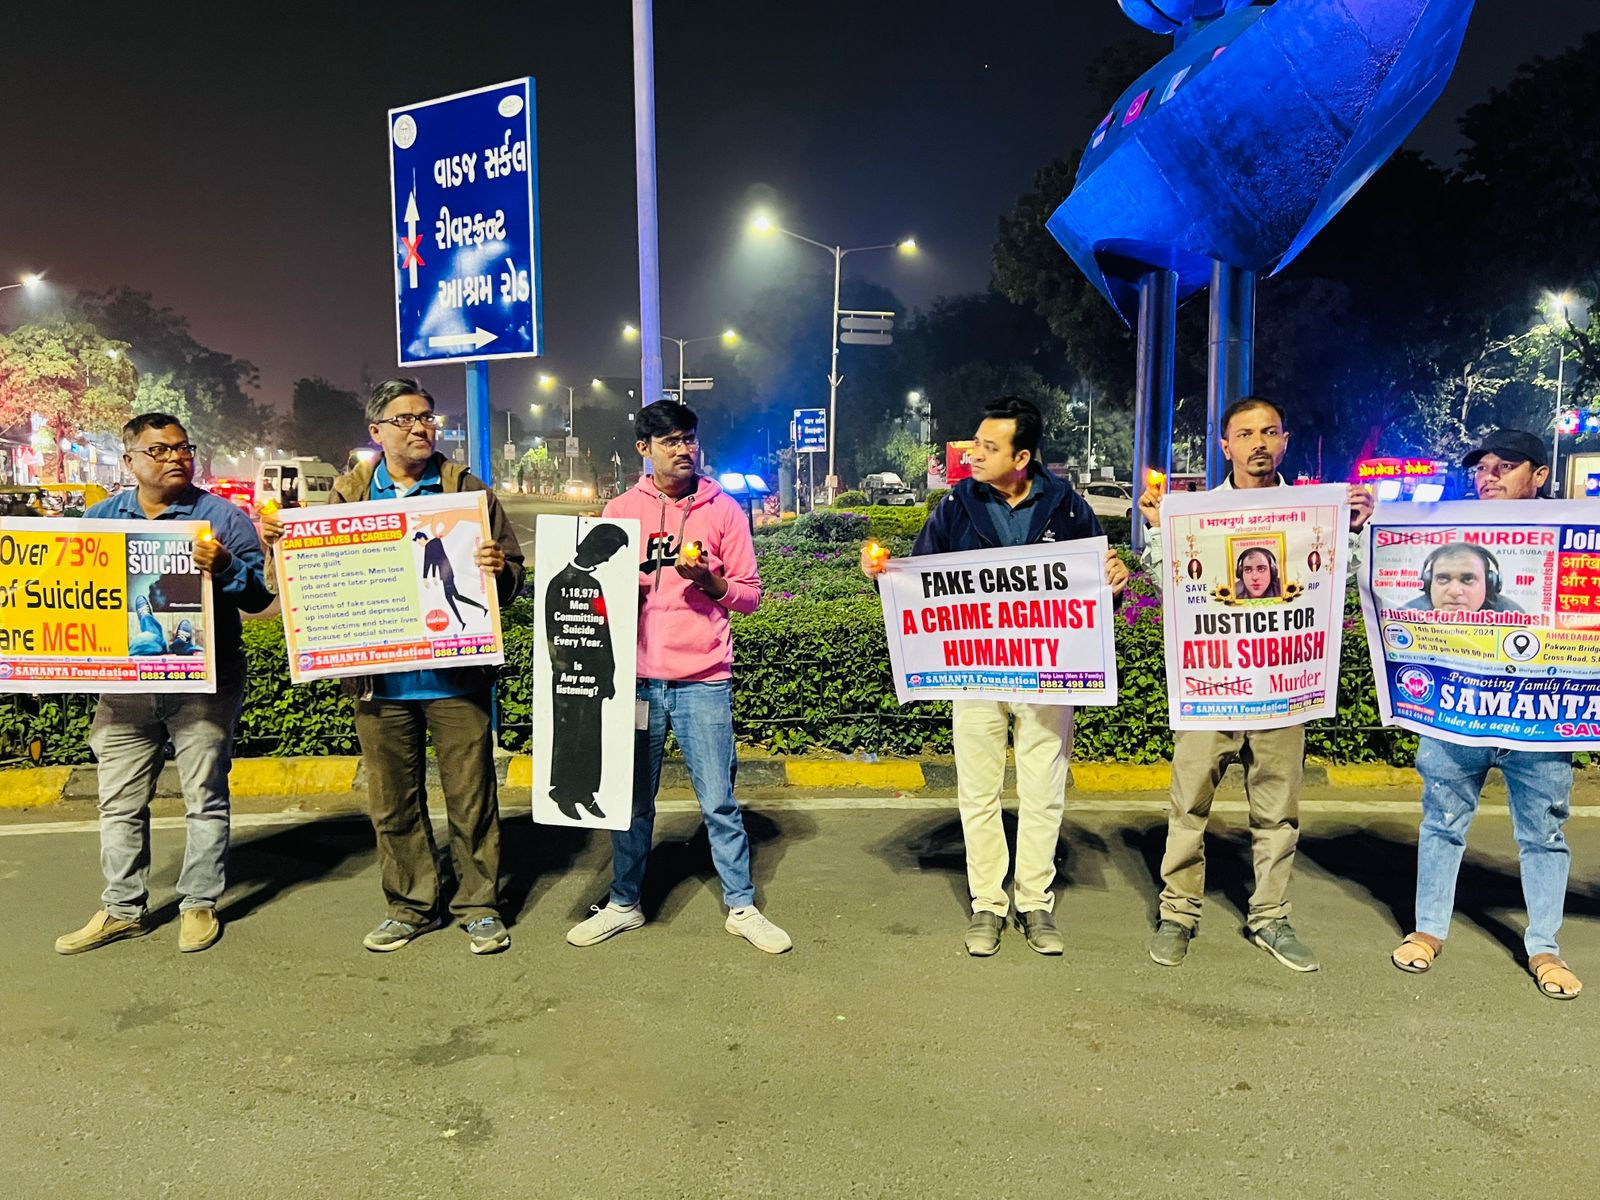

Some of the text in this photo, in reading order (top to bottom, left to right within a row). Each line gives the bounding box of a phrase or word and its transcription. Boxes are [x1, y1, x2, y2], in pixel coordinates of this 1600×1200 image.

[434, 128, 527, 189] વાડજ સર્કલ
[438, 257, 530, 309] આશ્રમ રોડ
[282, 515, 402, 539] FAKE CASES
[281, 530, 403, 550] CAN END LIVES & CAREERS
[1464, 531, 1555, 546] MURDER
[0, 534, 110, 568] Over 73%
[128, 540, 193, 555] STOP MAL
[296, 545, 397, 560] Mere allegation does not
[128, 554, 201, 575] SUICIDE
[298, 559, 342, 571] prove guilt
[299, 574, 307, 582] In
[309, 570, 339, 581] several
[368, 567, 387, 576] Men
[389, 565, 405, 574] lose
[920, 561, 1069, 599] FAKE CASE IS
[1378, 568, 1399, 577] Save
[1560, 571, 1588, 588] और
[301, 582, 315, 592] job
[316, 581, 331, 590] and
[347, 578, 368, 587] later
[370, 575, 398, 587] proved
[1185, 583, 1208, 593] SAVE
[1307, 581, 1320, 590] RIP
[1396, 580, 1423, 588] Nation
[1515, 575, 1535, 586] RIP
[25, 579, 123, 610] Suicides
[302, 590, 337, 600] innocent
[1187, 595, 1207, 604] MEN
[303, 596, 407, 611] Victims of fake cases end
[569, 600, 590, 611] Men
[305, 605, 410, 622] up isolated and depressed
[553, 611, 605, 626] Committing
[903, 598, 1097, 635] A CRIME AGAINST
[1194, 607, 1315, 635] JUSTICE FOR
[1380, 608, 1550, 627] #JusticeForAtulSubhash
[306, 624, 329, 633] Some
[331, 620, 363, 631] victims
[365, 620, 377, 628] end
[379, 617, 398, 626] their
[400, 616, 418, 625] lives
[562, 624, 596, 636] Suicide
[0, 622, 112, 653] are MEN...
[307, 626, 405, 642] because of social shame
[1415, 634, 1447, 645] Saturday
[1473, 628, 1495, 637] 2024
[553, 636, 604, 648] Every Year.
[1544, 643, 1576, 652] Pakwan
[315, 651, 368, 665] SAMANTA
[368, 646, 431, 661] Foundation
[943, 638, 1060, 667] HUMANITY
[1182, 631, 1326, 670] ATUL SUBHASH
[1543, 653, 1564, 662] Cross
[15, 666, 69, 677] SAMANTA
[71, 666, 137, 677] Foundation
[573, 661, 583, 671] Is
[141, 671, 165, 680] 8882
[560, 672, 596, 685] Any one
[925, 674, 1037, 686] SAMANTA Foundation
[1185, 669, 1321, 697] Suicide Murder
[556, 684, 599, 698] listening?
[1040, 680, 1104, 688] 8882 498 498
[1515, 678, 1561, 693] family
[1196, 704, 1239, 713] SAMANTA
[1240, 701, 1287, 713] Foundation
[1439, 683, 1600, 720] SAMANTA
[1438, 711, 1466, 727] Under
[1468, 719, 1488, 730] the
[1489, 722, 1521, 734] aegis
